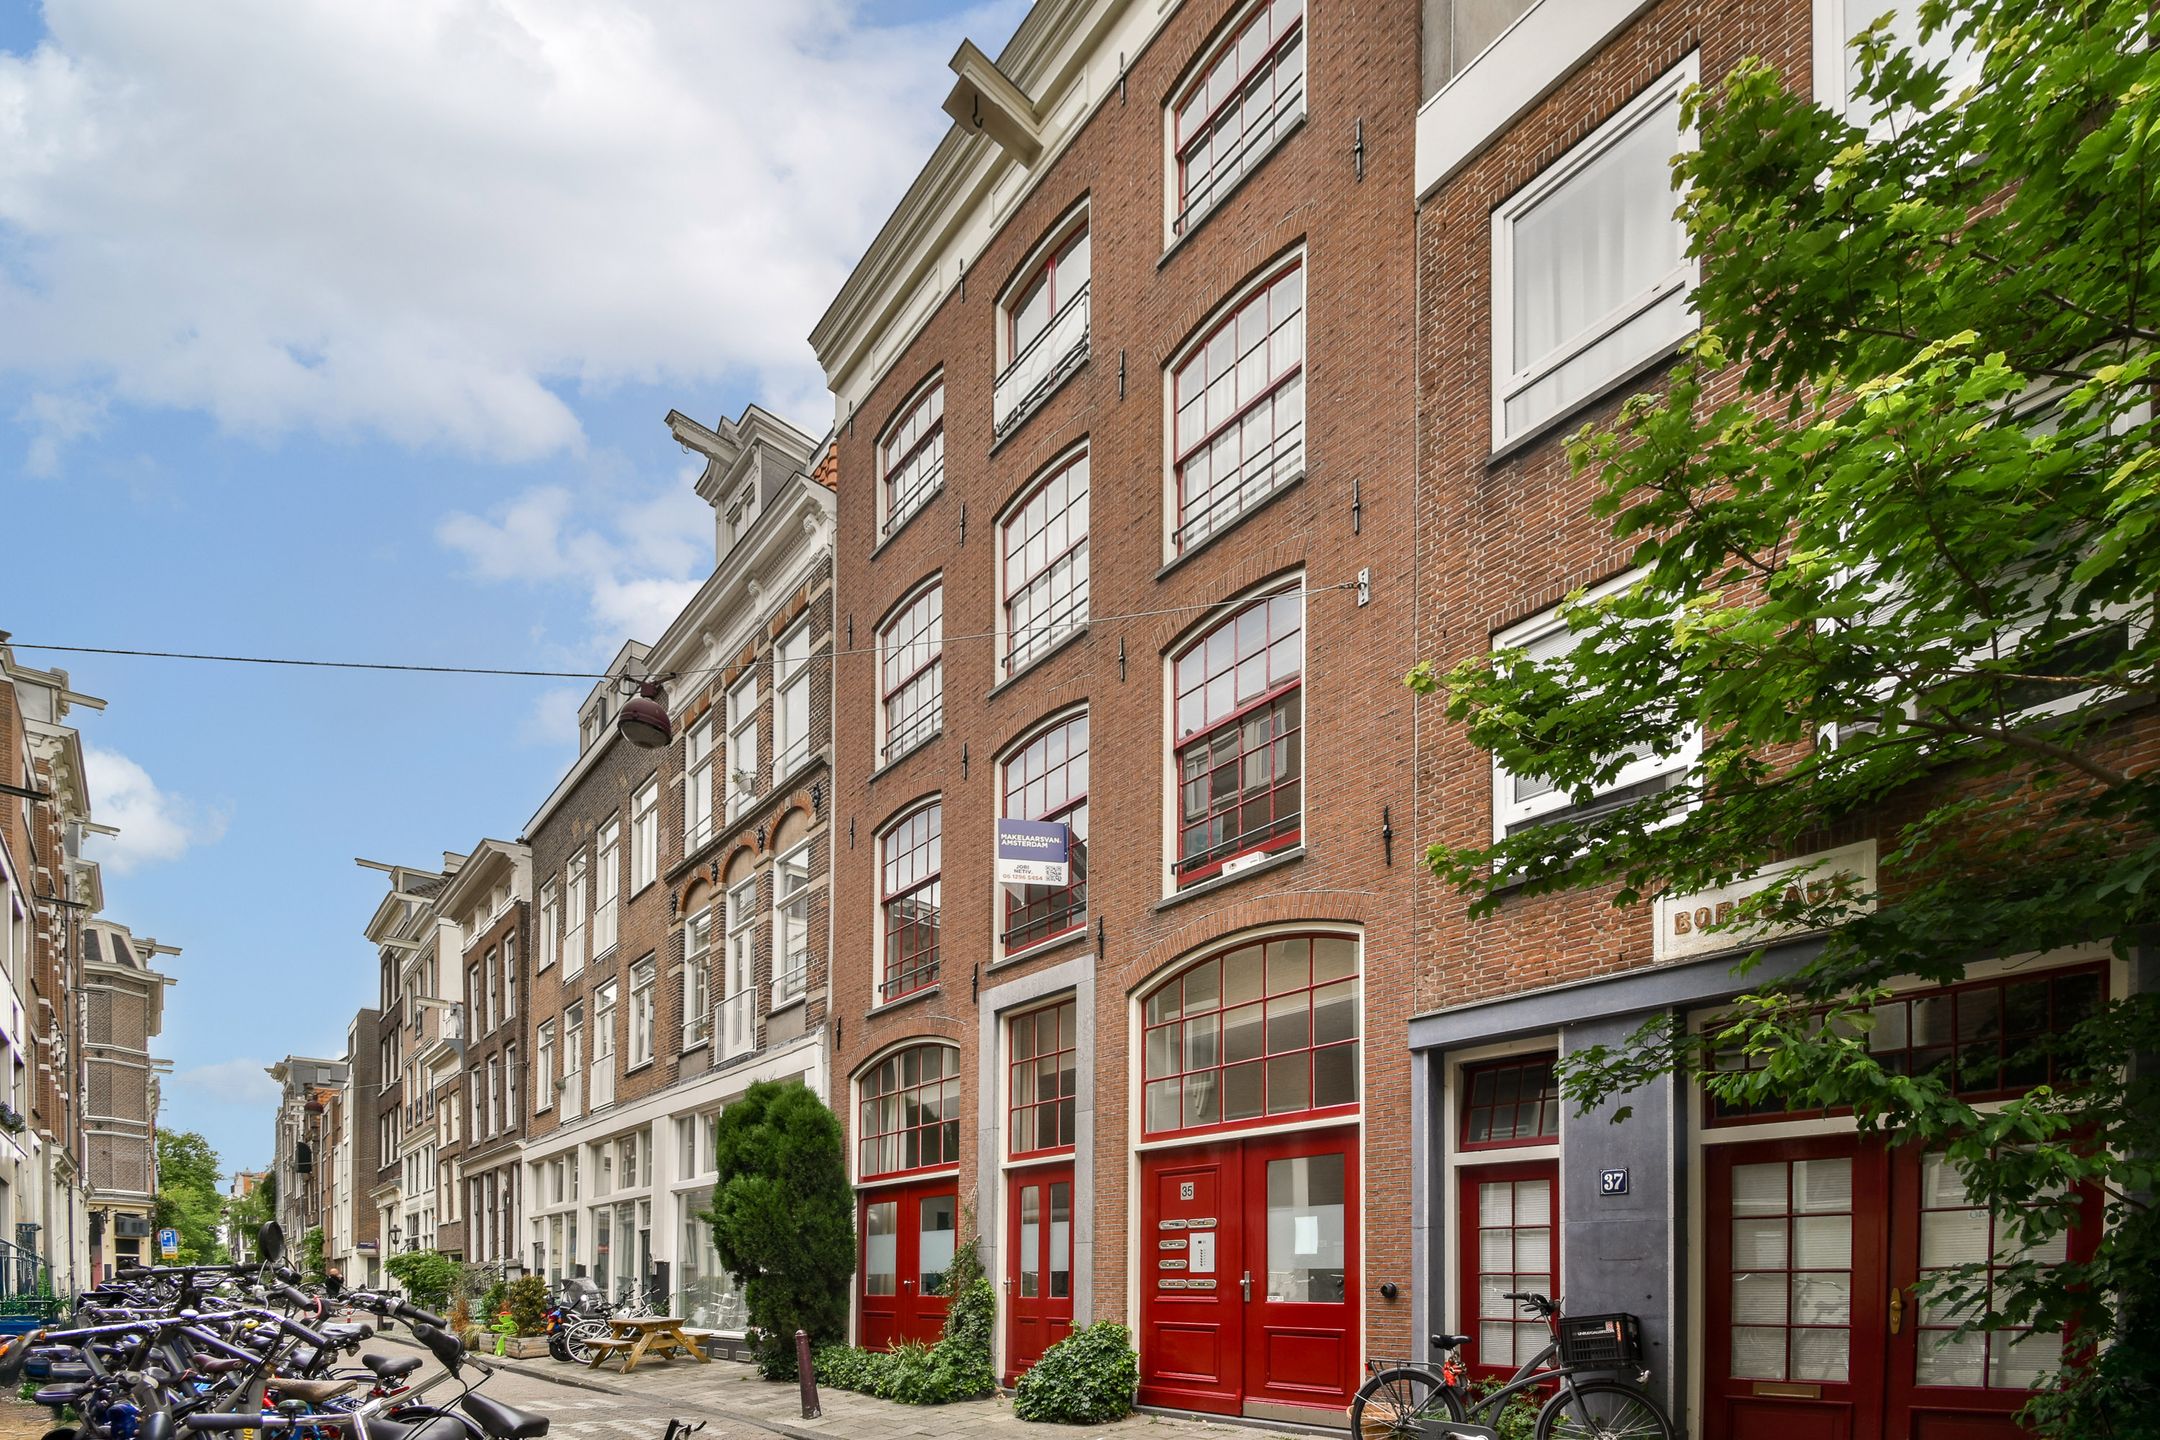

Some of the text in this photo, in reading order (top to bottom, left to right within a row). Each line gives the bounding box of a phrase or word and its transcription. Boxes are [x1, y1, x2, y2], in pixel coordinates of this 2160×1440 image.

[1001, 839, 1049, 849] AMSTERDAM
[1603, 1173, 1624, 1191] 37
[1181, 1185, 1193, 1197] 35
[163, 1231, 172, 1241] P
